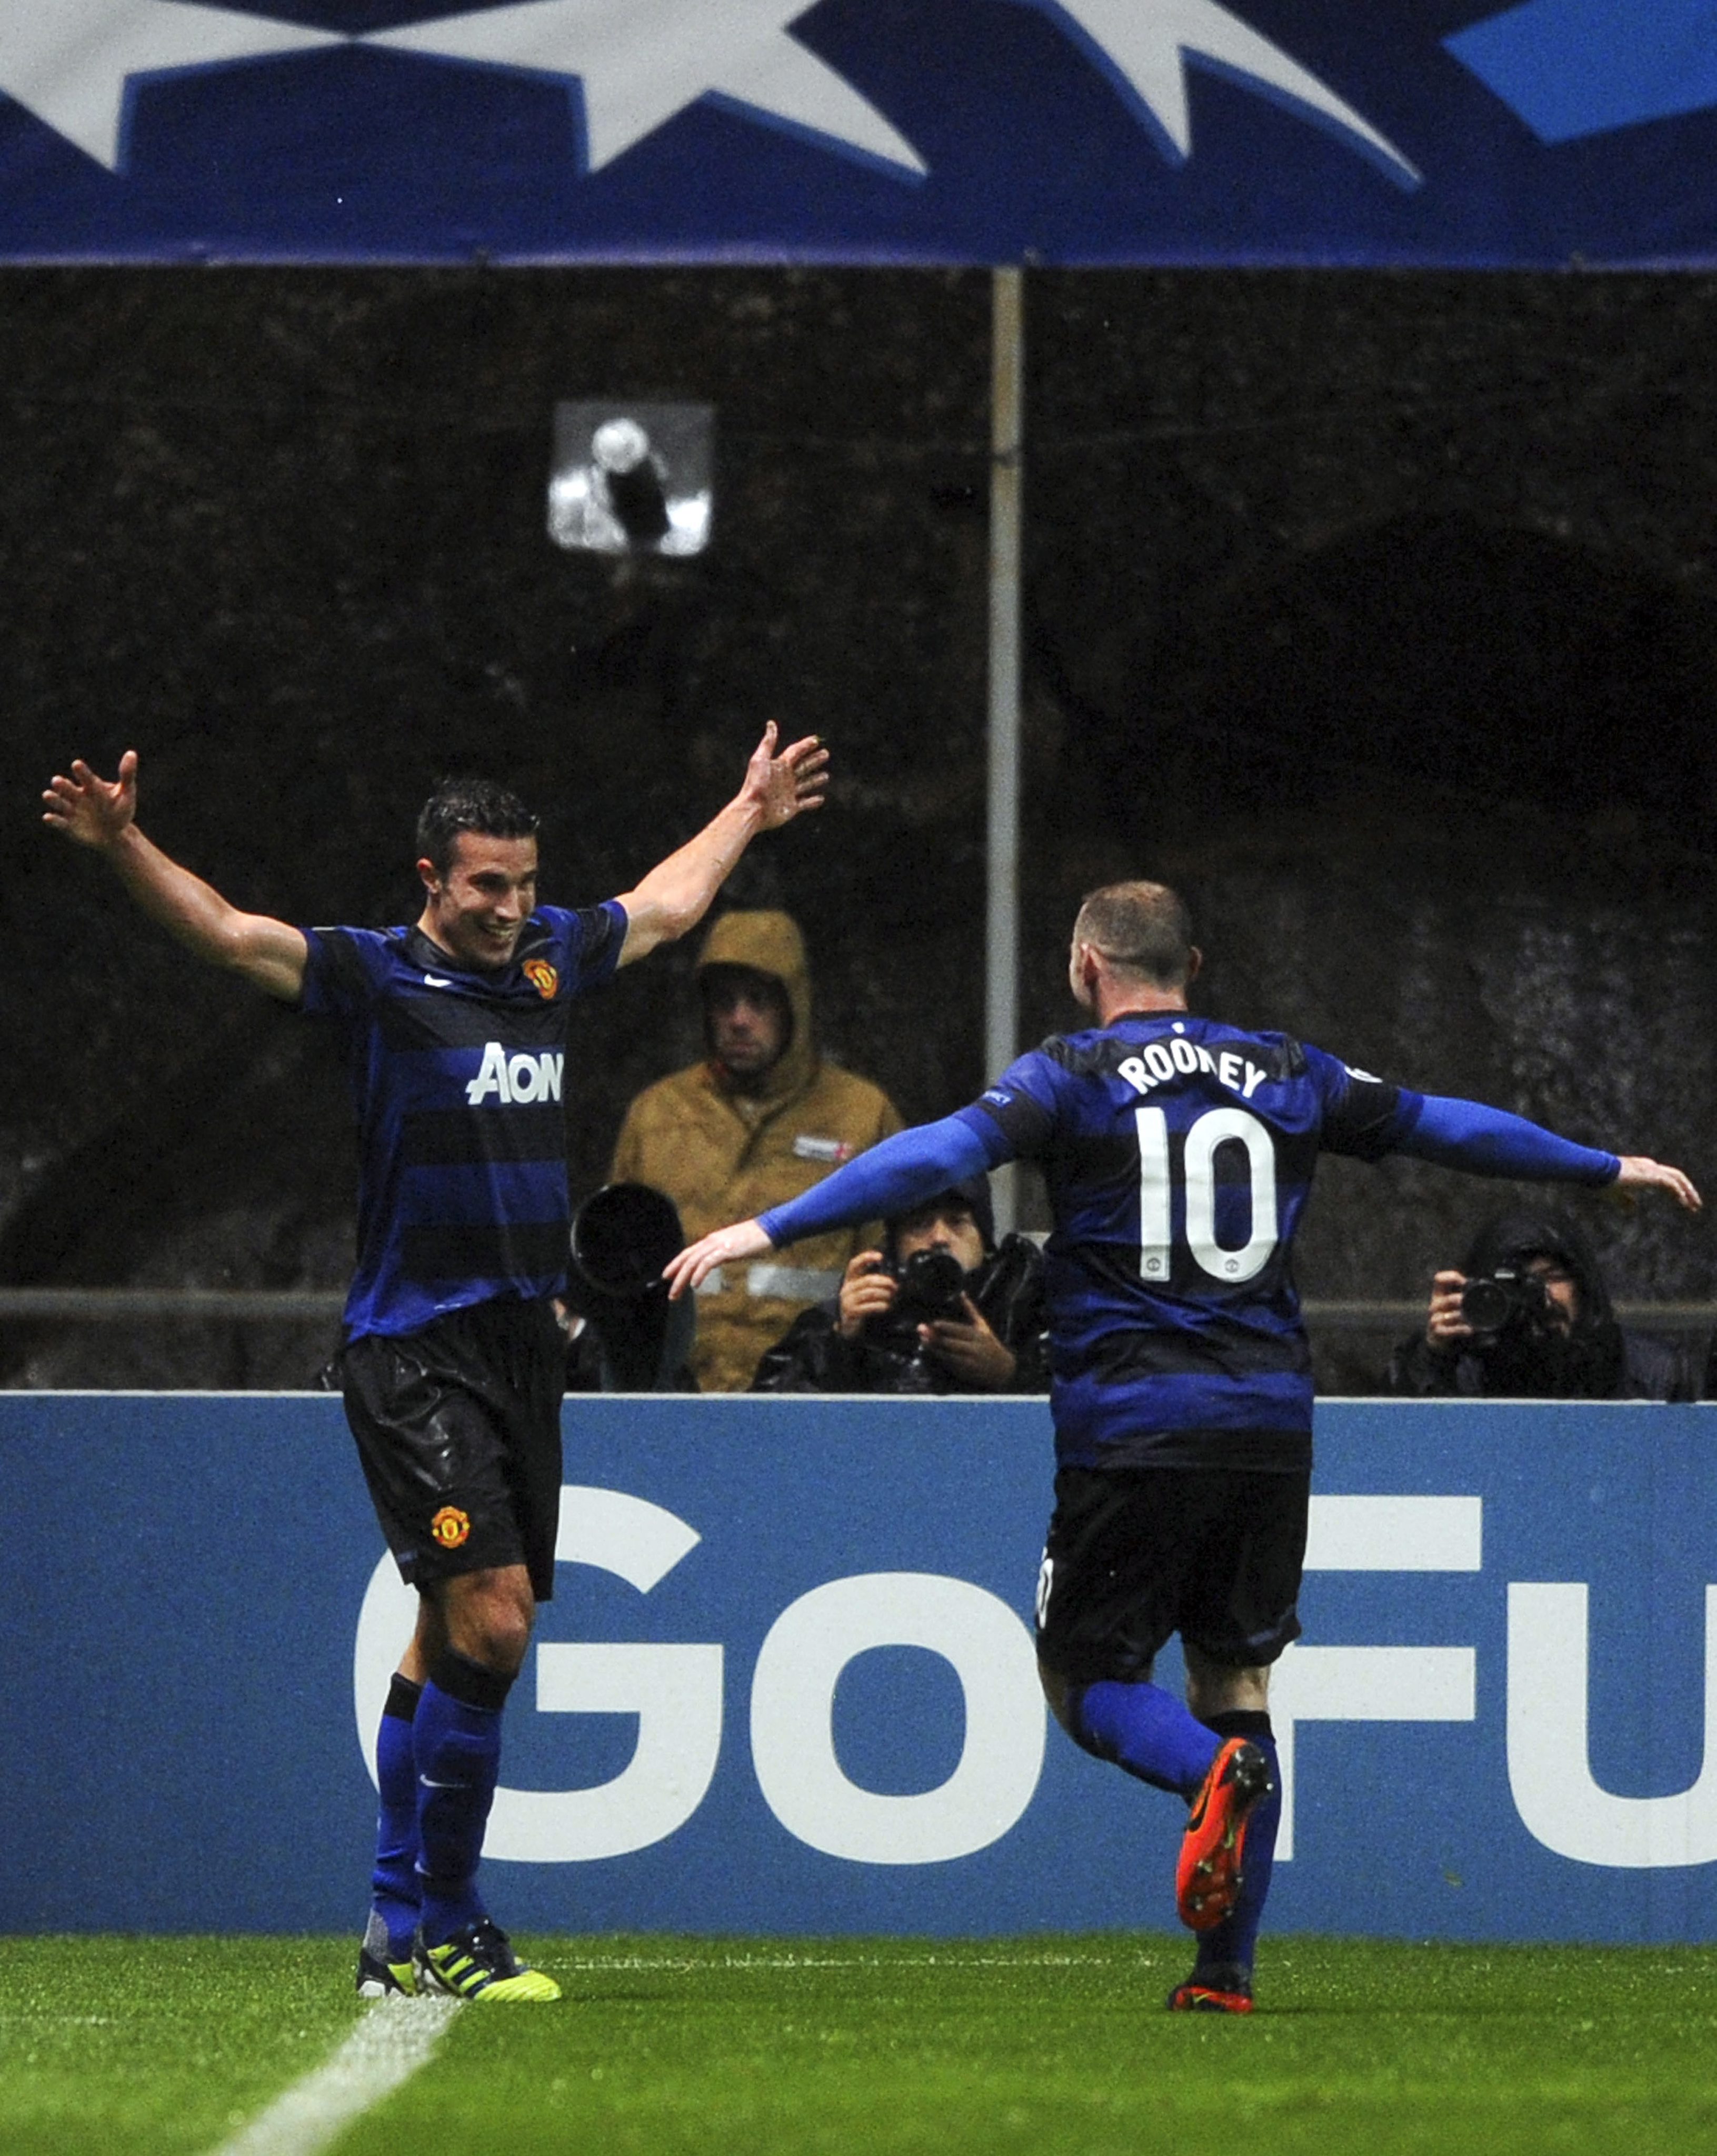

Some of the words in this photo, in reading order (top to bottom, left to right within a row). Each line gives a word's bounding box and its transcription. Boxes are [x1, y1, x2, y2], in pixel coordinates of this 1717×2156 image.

[465, 1042, 564, 1105] AON
[1117, 1038, 1267, 1099] ROONEY
[1134, 1106, 1279, 1283] 10
[354, 1484, 1047, 1865] Go
